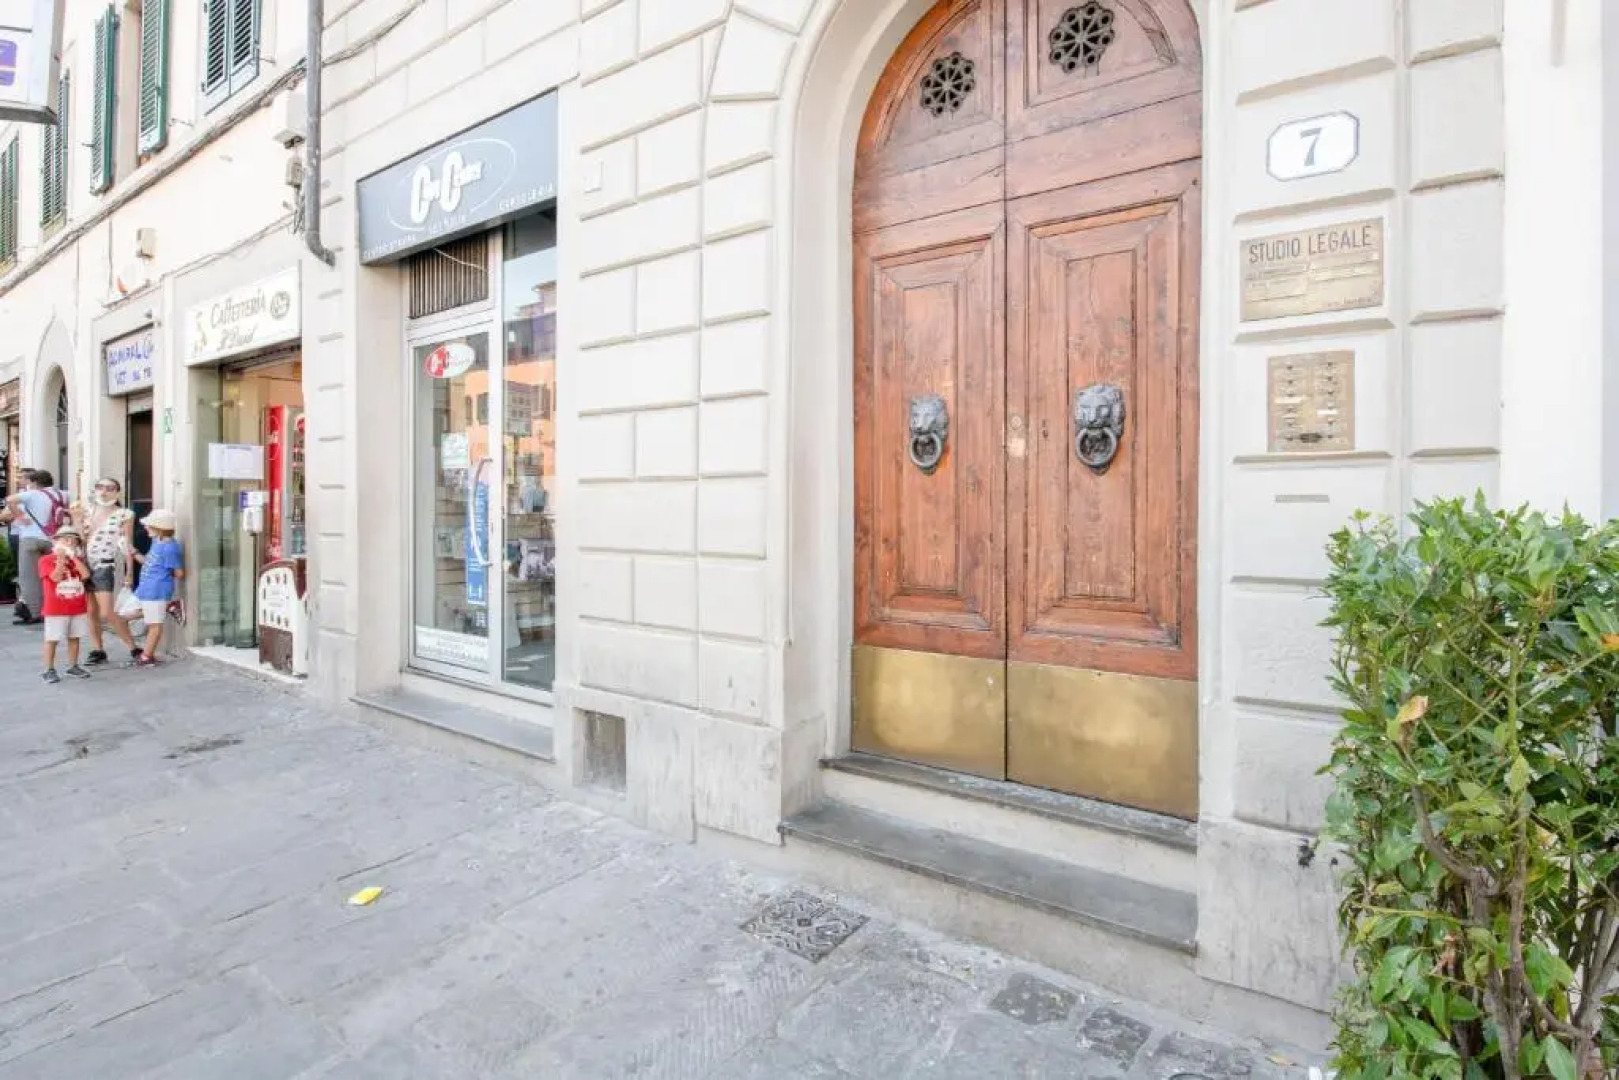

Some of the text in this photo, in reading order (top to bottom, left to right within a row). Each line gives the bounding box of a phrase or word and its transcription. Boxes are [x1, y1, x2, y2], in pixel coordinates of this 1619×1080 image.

[1300, 127, 1323, 167] 7
[1248, 225, 1373, 265] STUDIO LEGALE
